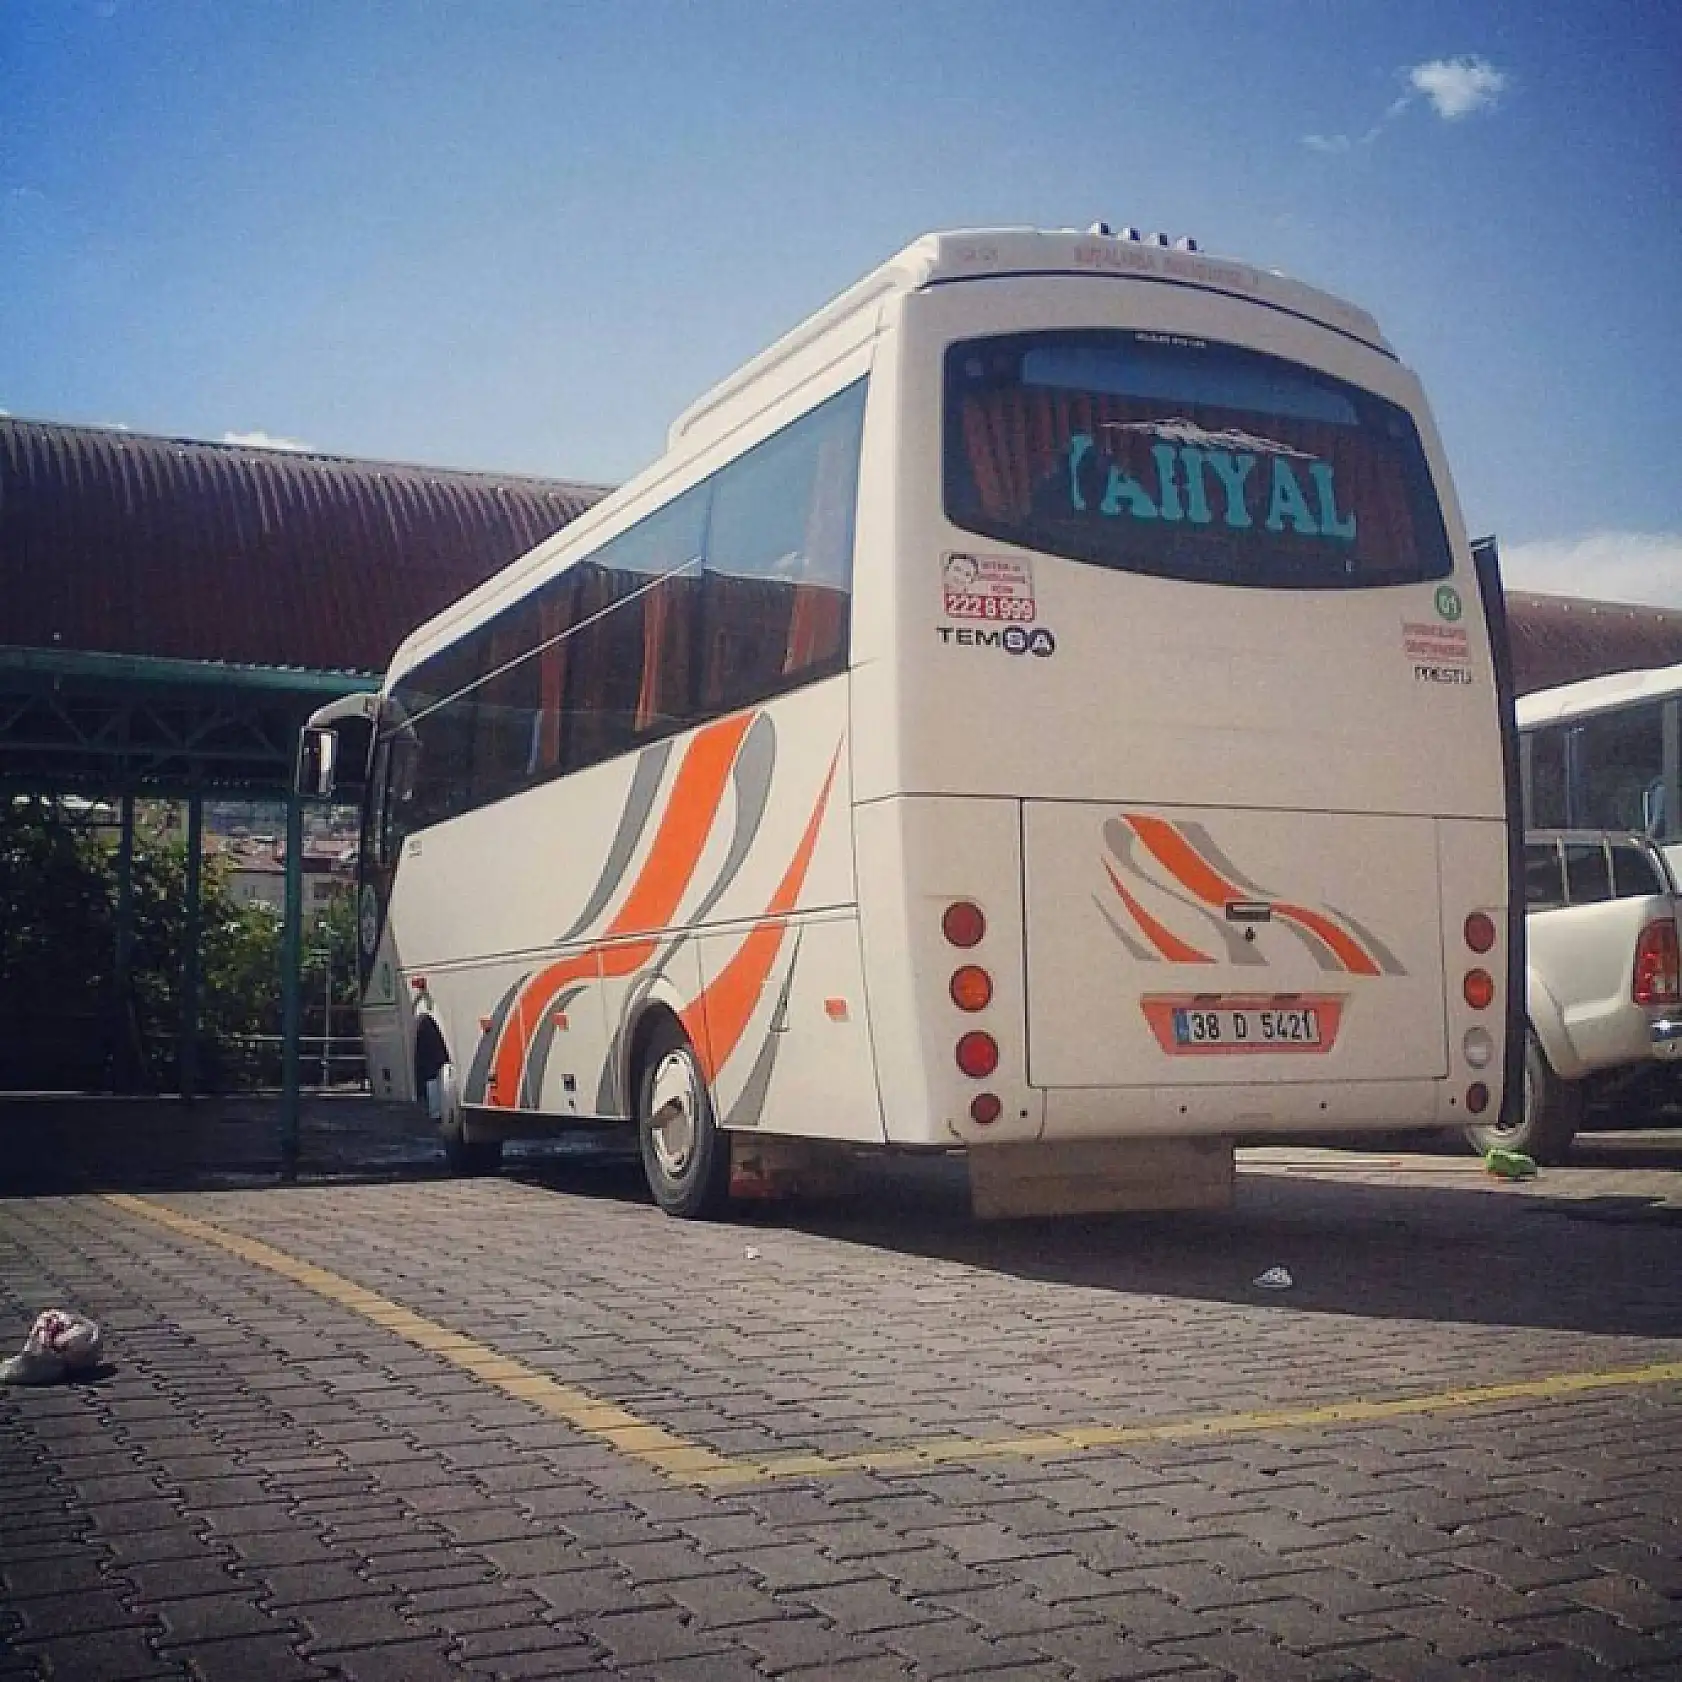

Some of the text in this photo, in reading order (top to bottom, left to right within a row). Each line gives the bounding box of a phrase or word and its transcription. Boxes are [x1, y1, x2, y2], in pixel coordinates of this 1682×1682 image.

[947, 595, 1033, 620] 222 8 999
[936, 625, 1055, 657] TEMSA
[1192, 1009, 1313, 1040] 38 D 5421
